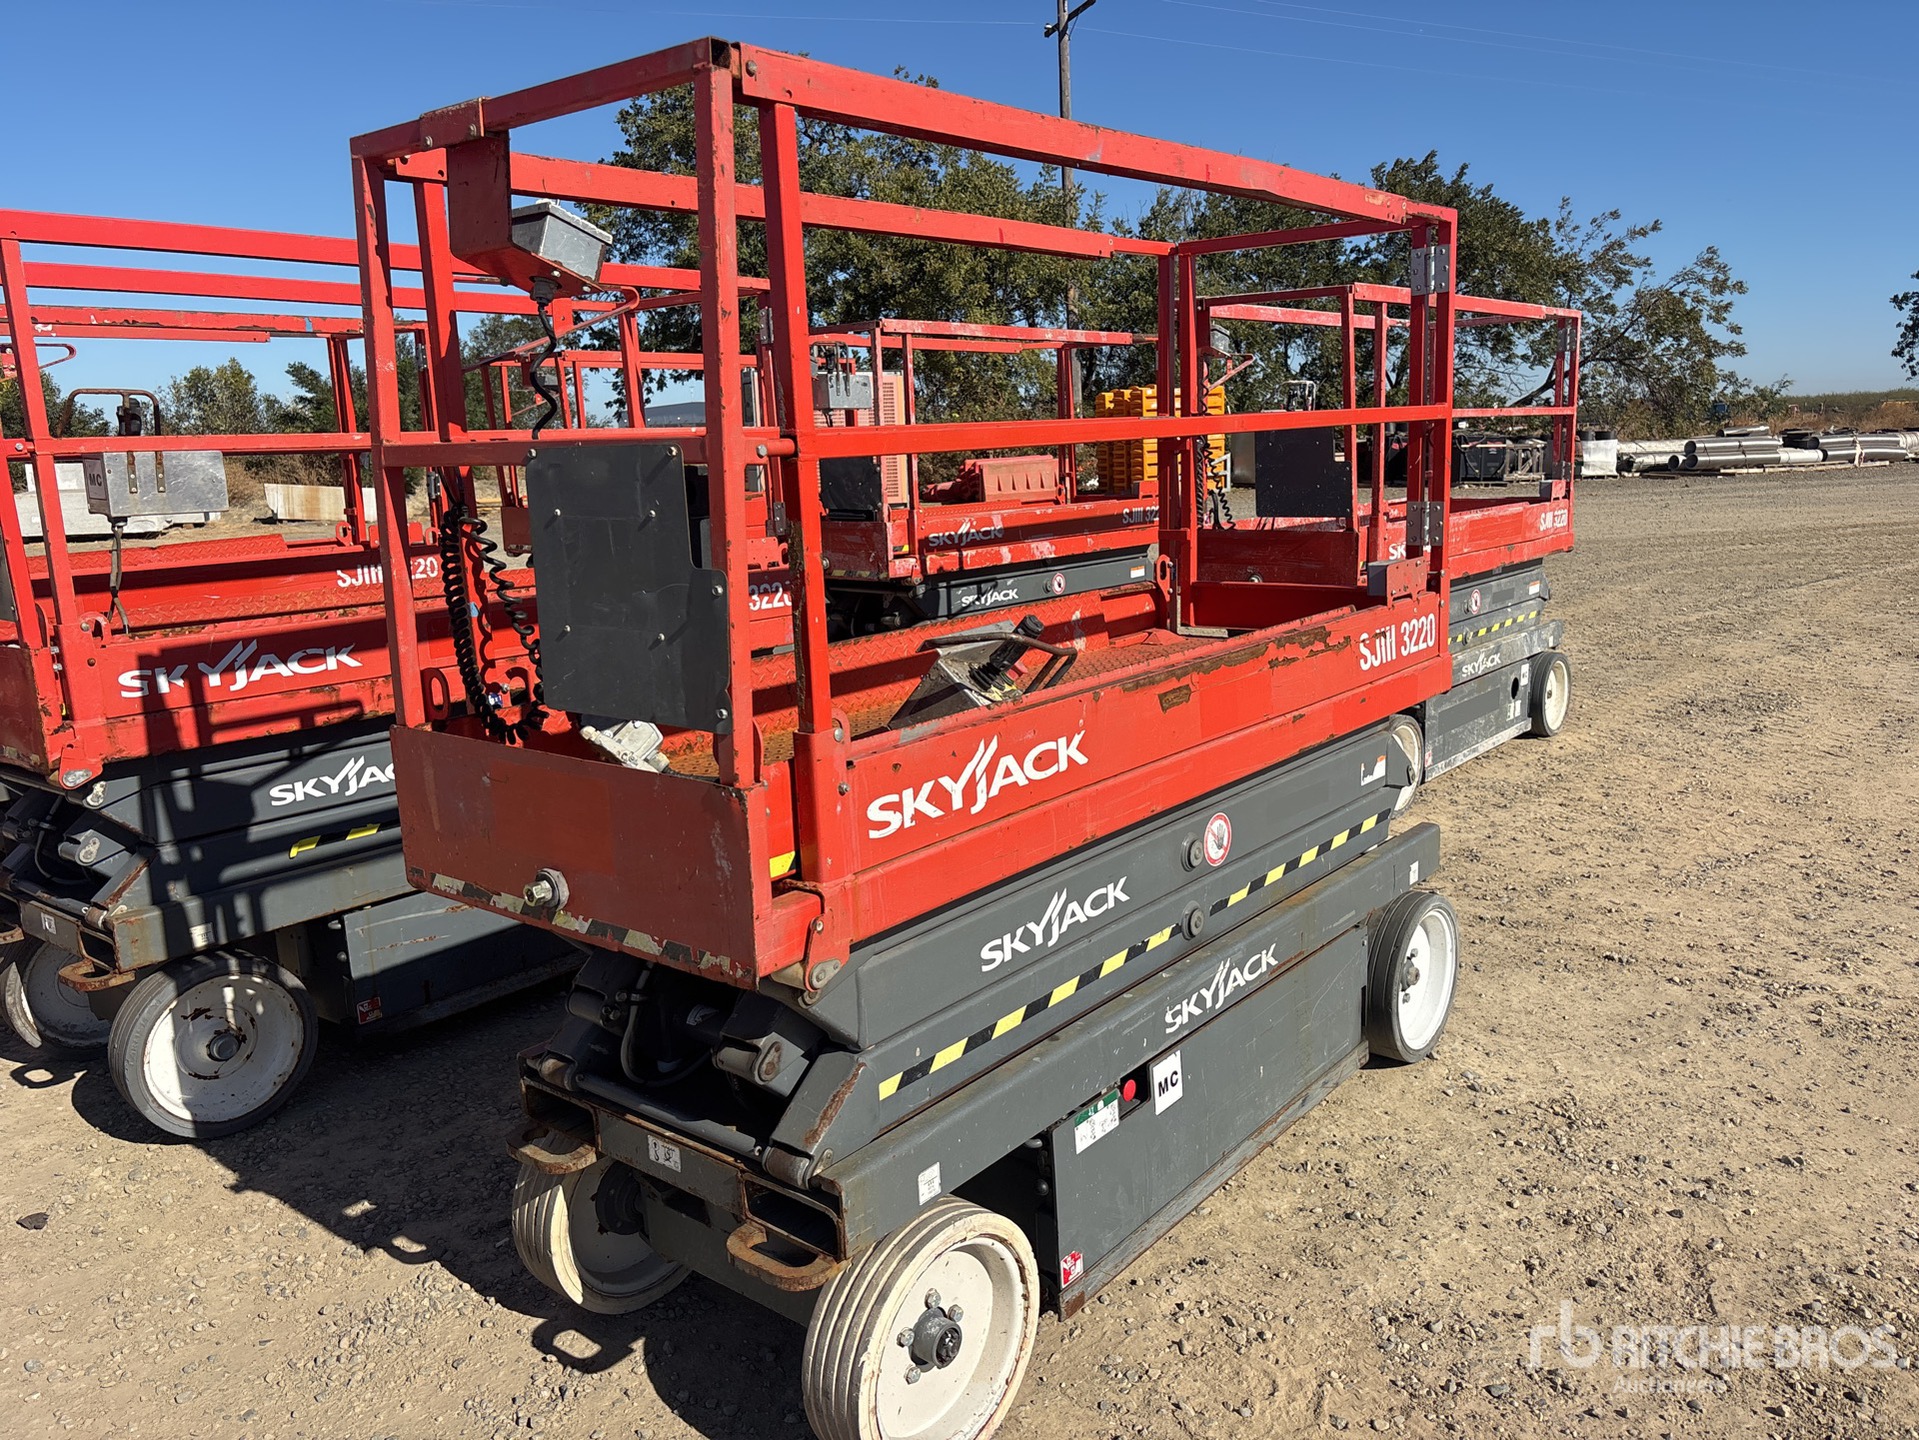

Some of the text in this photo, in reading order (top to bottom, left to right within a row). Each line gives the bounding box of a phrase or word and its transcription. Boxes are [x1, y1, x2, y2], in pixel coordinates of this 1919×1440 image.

[89, 473, 103, 487] MC
[1145, 506, 1160, 521] 322
[928, 518, 1003, 546] SKYJACK
[411, 556, 439, 580] 20
[961, 587, 1019, 607] SKYJACK
[1359, 612, 1436, 671] SJIII 3220
[118, 639, 363, 698] SKYJACK
[1461, 652, 1502, 677] SKYJACK
[269, 755, 395, 806] SKYJA
[866, 730, 1089, 839] SKYJACK
[980, 876, 1130, 972] SKYJACK
[1164, 943, 1279, 1034] SKYJACK
[1158, 1070, 1179, 1098] MC
